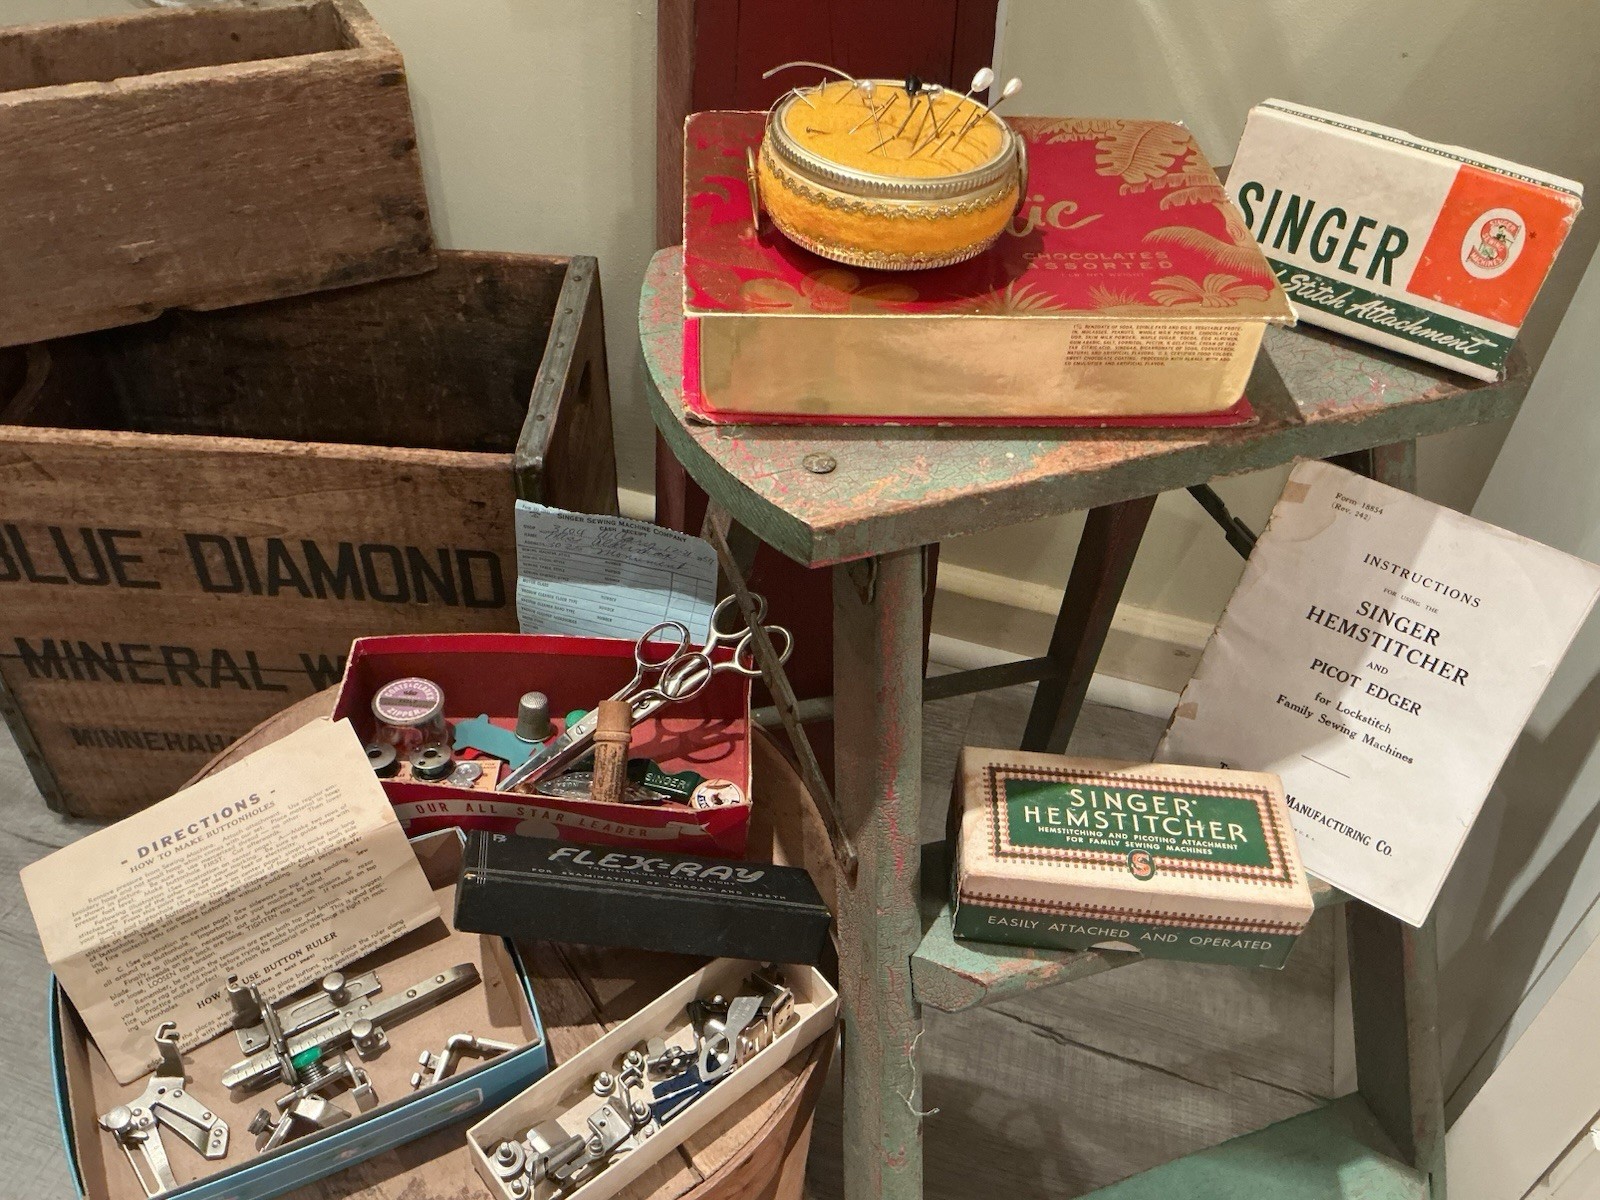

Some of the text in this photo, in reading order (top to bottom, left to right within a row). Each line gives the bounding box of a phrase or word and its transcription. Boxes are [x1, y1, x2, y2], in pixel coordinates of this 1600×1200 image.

[1330, 121, 1371, 137] SEWING
[1378, 134, 1415, 148] FAMILY
[1238, 181, 1409, 287] SINGER
[1022, 252, 1168, 261] CHOCOLATES
[1028, 262, 1172, 270] ASSORTED
[1283, 274, 1499, 354] Stitch Attachment
[1331, 502, 1351, 514] (Rev.
[1334, 492, 1357, 506] Form
[557, 513, 688, 543] SINGER SEWING MACHINE COMPANY
[183, 533, 506, 608] DIAMOND
[1363, 553, 1481, 608] INSTRUCTIONS
[1383, 588, 1440, 614] FOR USING THE
[1356, 600, 1441, 646] SINGER
[1305, 605, 1470, 687] HEMSTITCHER
[14, 637, 288, 692] MINERAL
[1366, 661, 1389, 675] AND
[1310, 658, 1422, 716] PICOT EDGER
[1276, 694, 1414, 764] Family Sewing Machines
[1314, 692, 1393, 734] for Lockstitch
[129, 800, 276, 873] HOW TO MAKE BUTTONHOLES
[136, 793, 261, 856] DIRECTIONS
[416, 802, 649, 838] OUR ALL STAR LEADER
[1024, 805, 1248, 843] HEMSTITCHER
[1038, 826, 1238, 851] HEMSTITCHING AND PICOTING ATTACHMENT
[1066, 836, 1213, 856] FOR FAMILY SEWING MACHINES
[562, 871, 640, 884] EXAMINATION
[669, 882, 713, 892] THROAT
[751, 892, 786, 900] TEETH
[246, 913, 278, 931] TIGHTEN
[988, 915, 1272, 951] EASILY ATTACHED AND OPERATED
[148, 970, 176, 987] LOOSEN
[196, 931, 337, 1009] HOW USE BUTTON RULER
